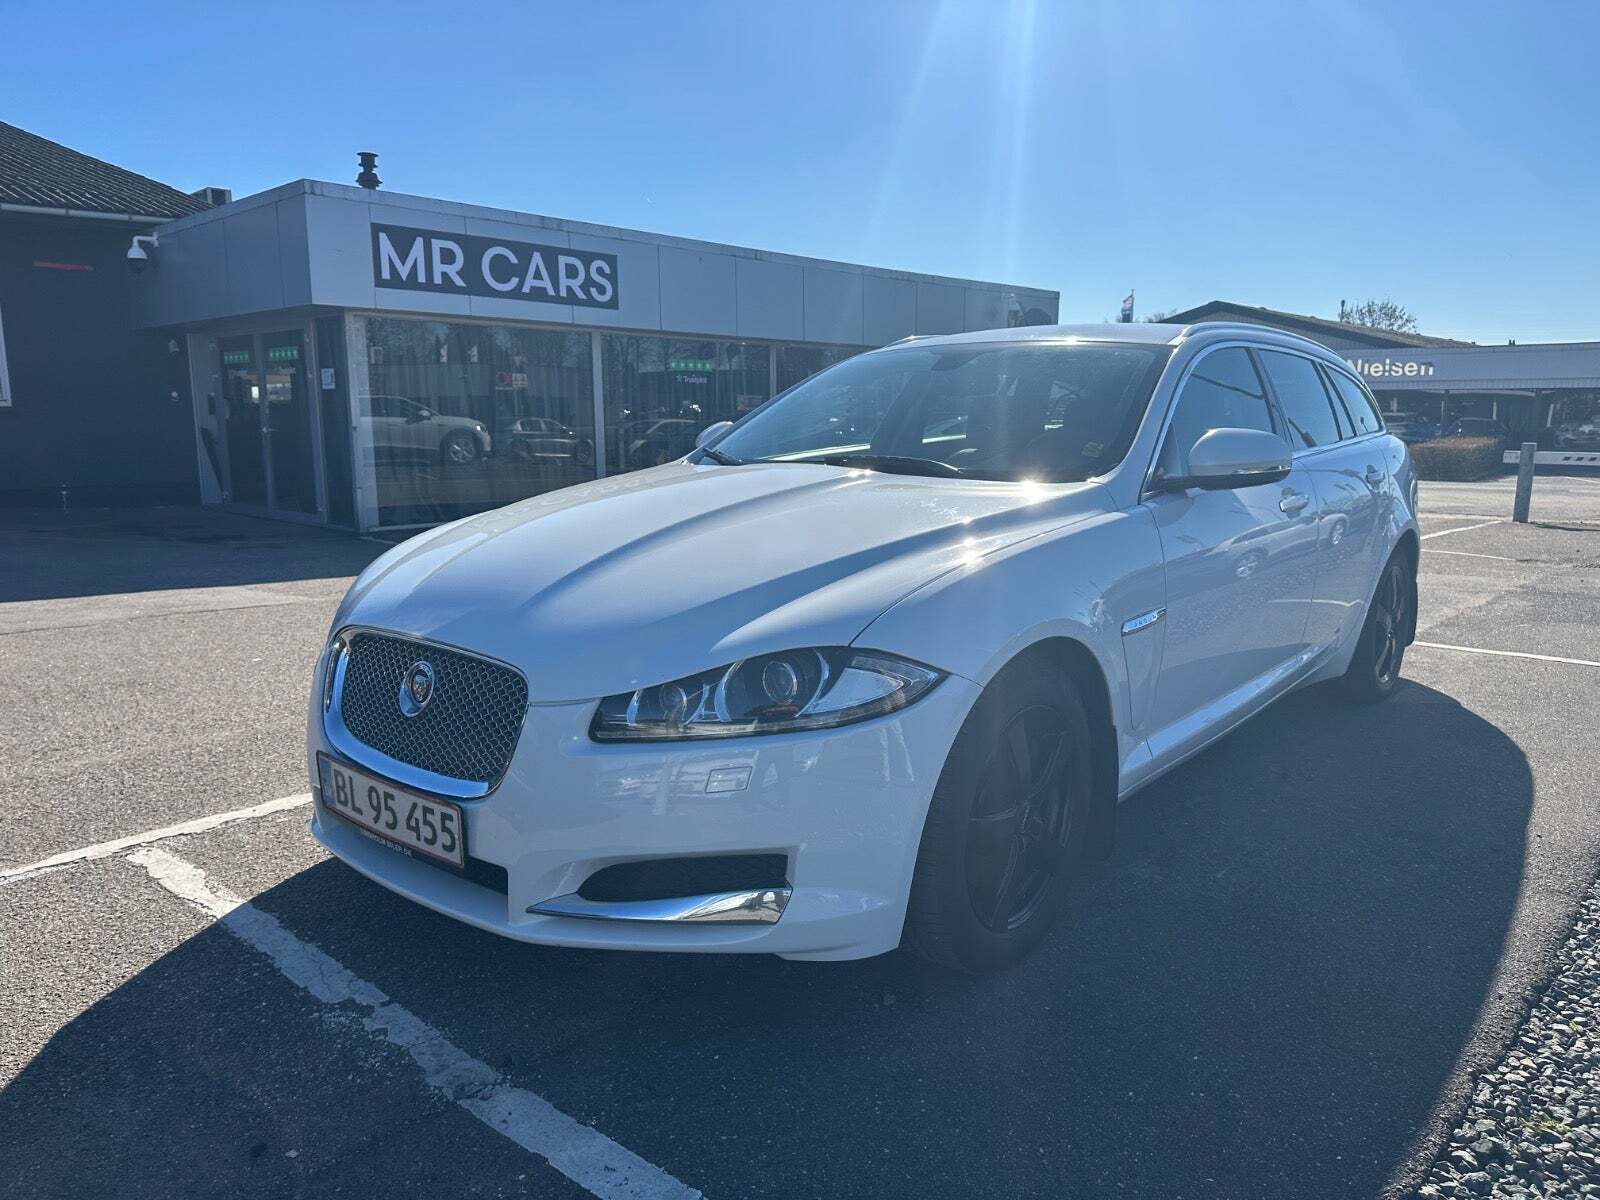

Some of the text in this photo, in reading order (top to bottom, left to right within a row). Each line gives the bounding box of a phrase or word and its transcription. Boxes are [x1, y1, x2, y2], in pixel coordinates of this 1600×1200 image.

[379, 232, 613, 302] MR CARS
[334, 769, 363, 816] BL
[367, 785, 398, 830] 95
[405, 802, 456, 853] 455
